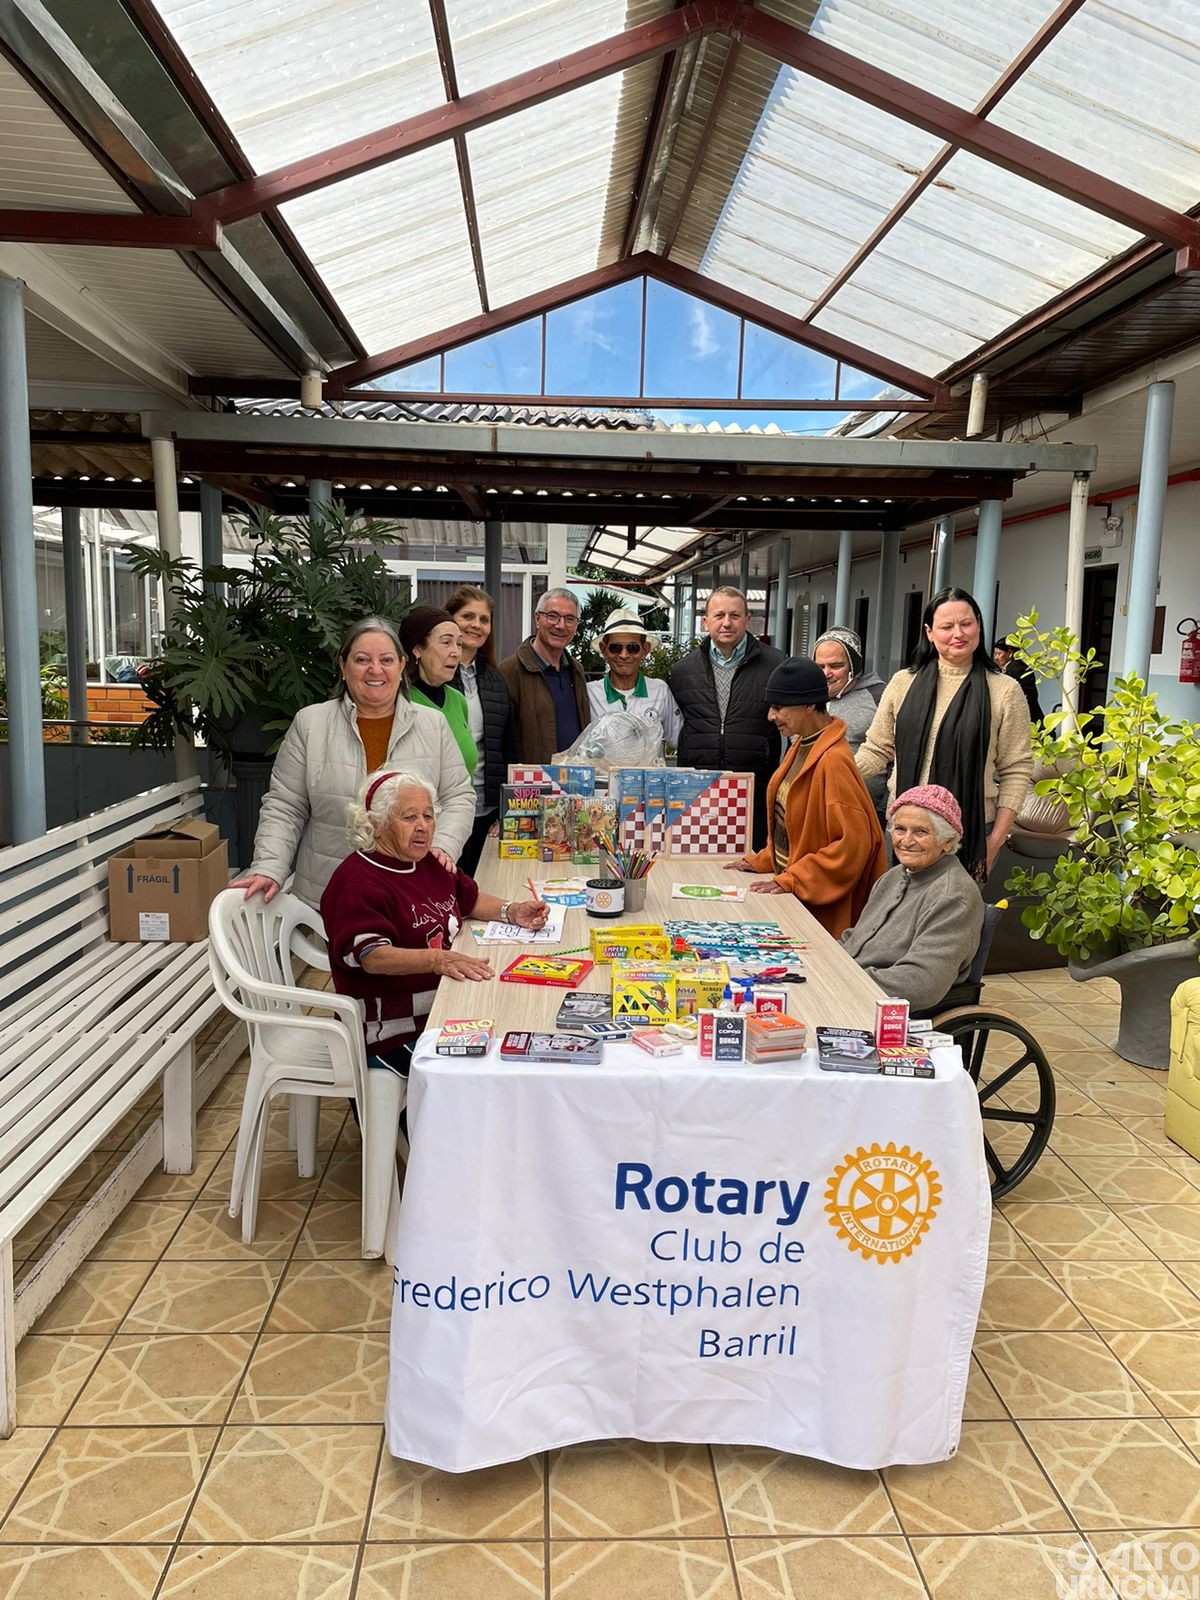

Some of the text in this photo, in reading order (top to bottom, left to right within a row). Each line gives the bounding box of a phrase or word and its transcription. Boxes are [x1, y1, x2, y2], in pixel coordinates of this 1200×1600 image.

[513, 788, 541, 800] SUPER
[508, 795, 541, 811] MEMÓR
[442, 1019, 494, 1034] UNO
[719, 1037, 740, 1045] DUNGA
[879, 1047, 929, 1056] UNO
[862, 1157, 917, 1174] ROTARY
[615, 1162, 810, 1226] Rotary
[841, 1212, 923, 1251] INTERNATIONAL
[650, 1228, 805, 1263] Club de
[567, 1269, 800, 1315] Westphalen
[699, 1326, 797, 1358] Barril
